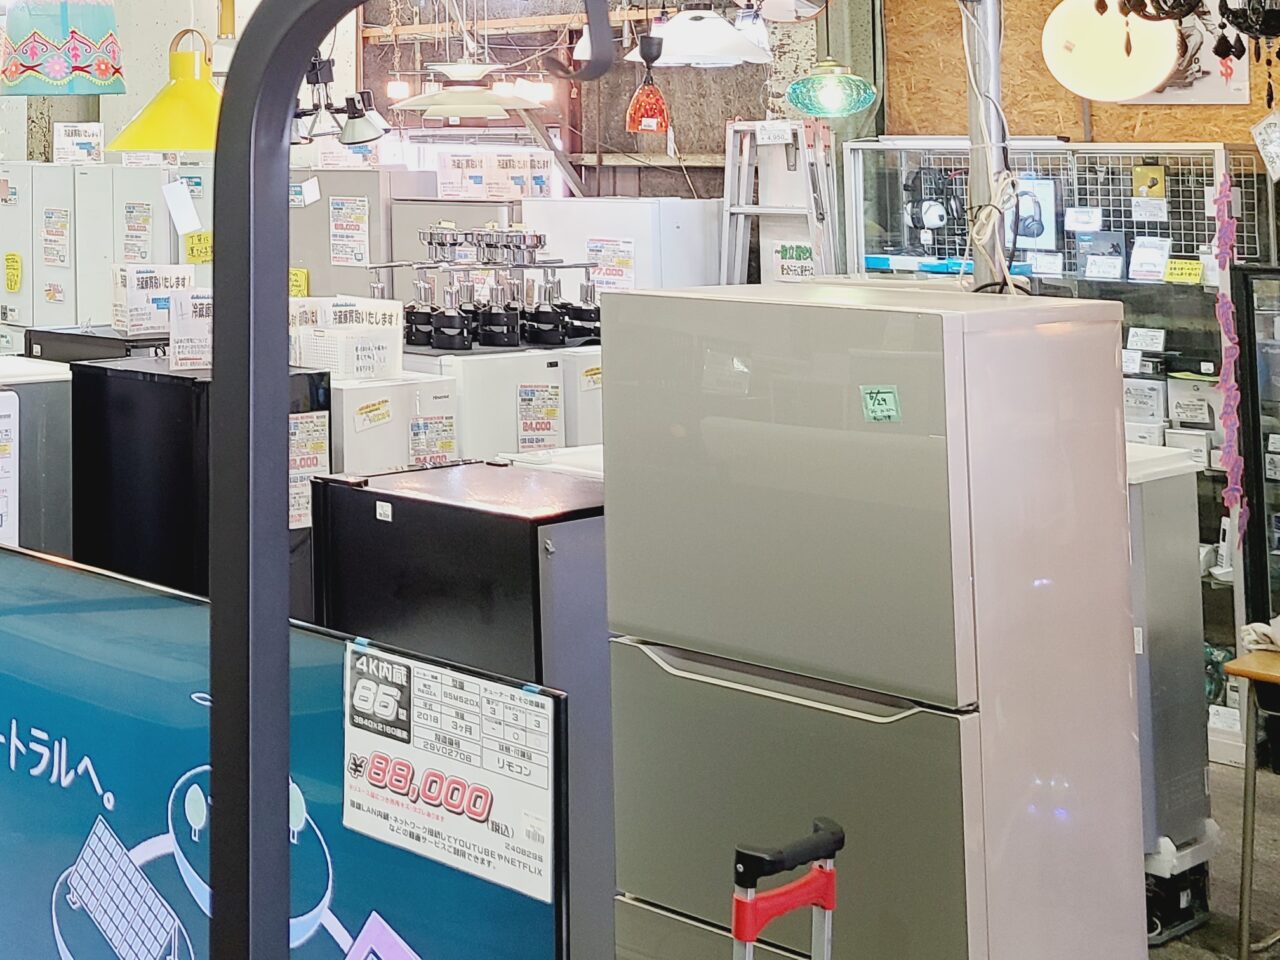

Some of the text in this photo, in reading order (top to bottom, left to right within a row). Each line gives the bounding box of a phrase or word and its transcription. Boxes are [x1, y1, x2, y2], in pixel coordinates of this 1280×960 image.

[356, 656, 408, 686] 4K内蔵
[489, 706, 497, 715] 3
[417, 711, 439, 724] 2018
[512, 713, 519, 722] 3
[534, 719, 541, 729] 3
[497, 757, 531, 777] リモコン
